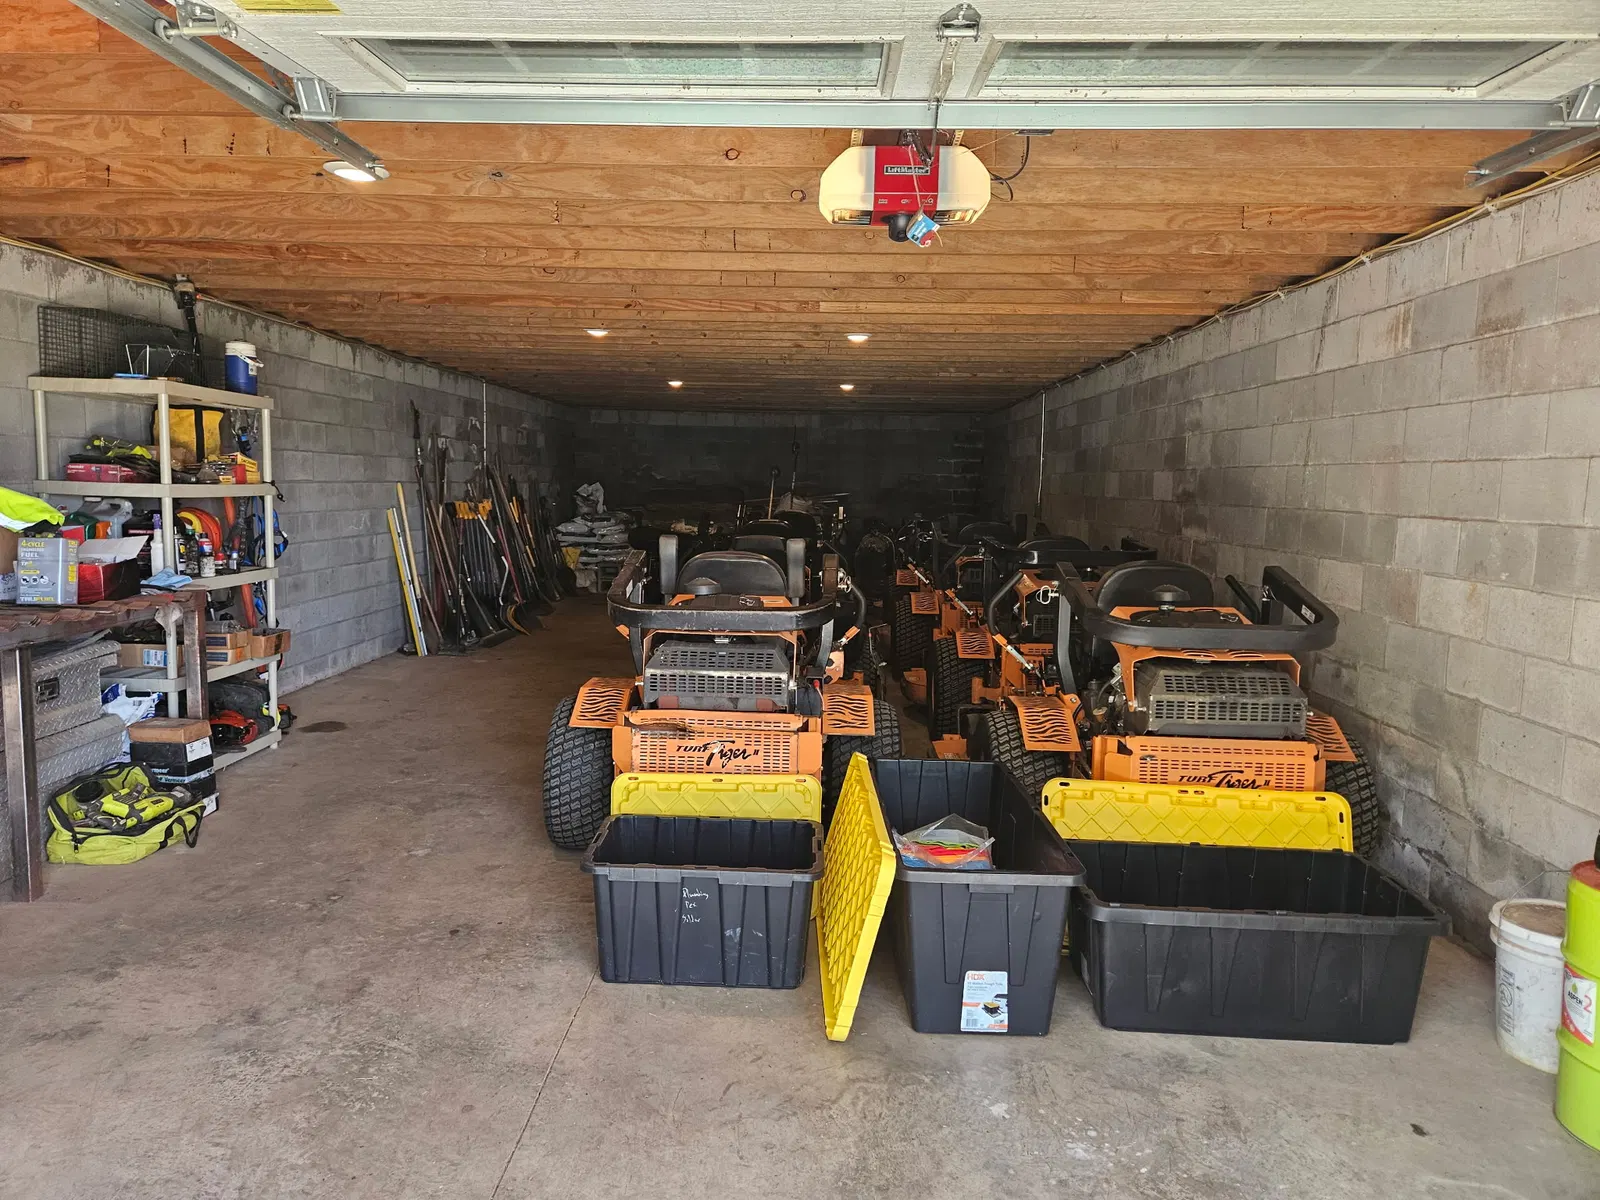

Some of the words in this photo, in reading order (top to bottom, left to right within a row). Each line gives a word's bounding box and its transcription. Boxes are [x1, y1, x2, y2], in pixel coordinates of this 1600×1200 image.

[676, 743, 711, 752] TURF
[703, 740, 751, 769] Tiger
[1178, 774, 1217, 783] TURF
[1568, 989, 1583, 1006] ASPEN
[1584, 994, 1592, 1014] 2
